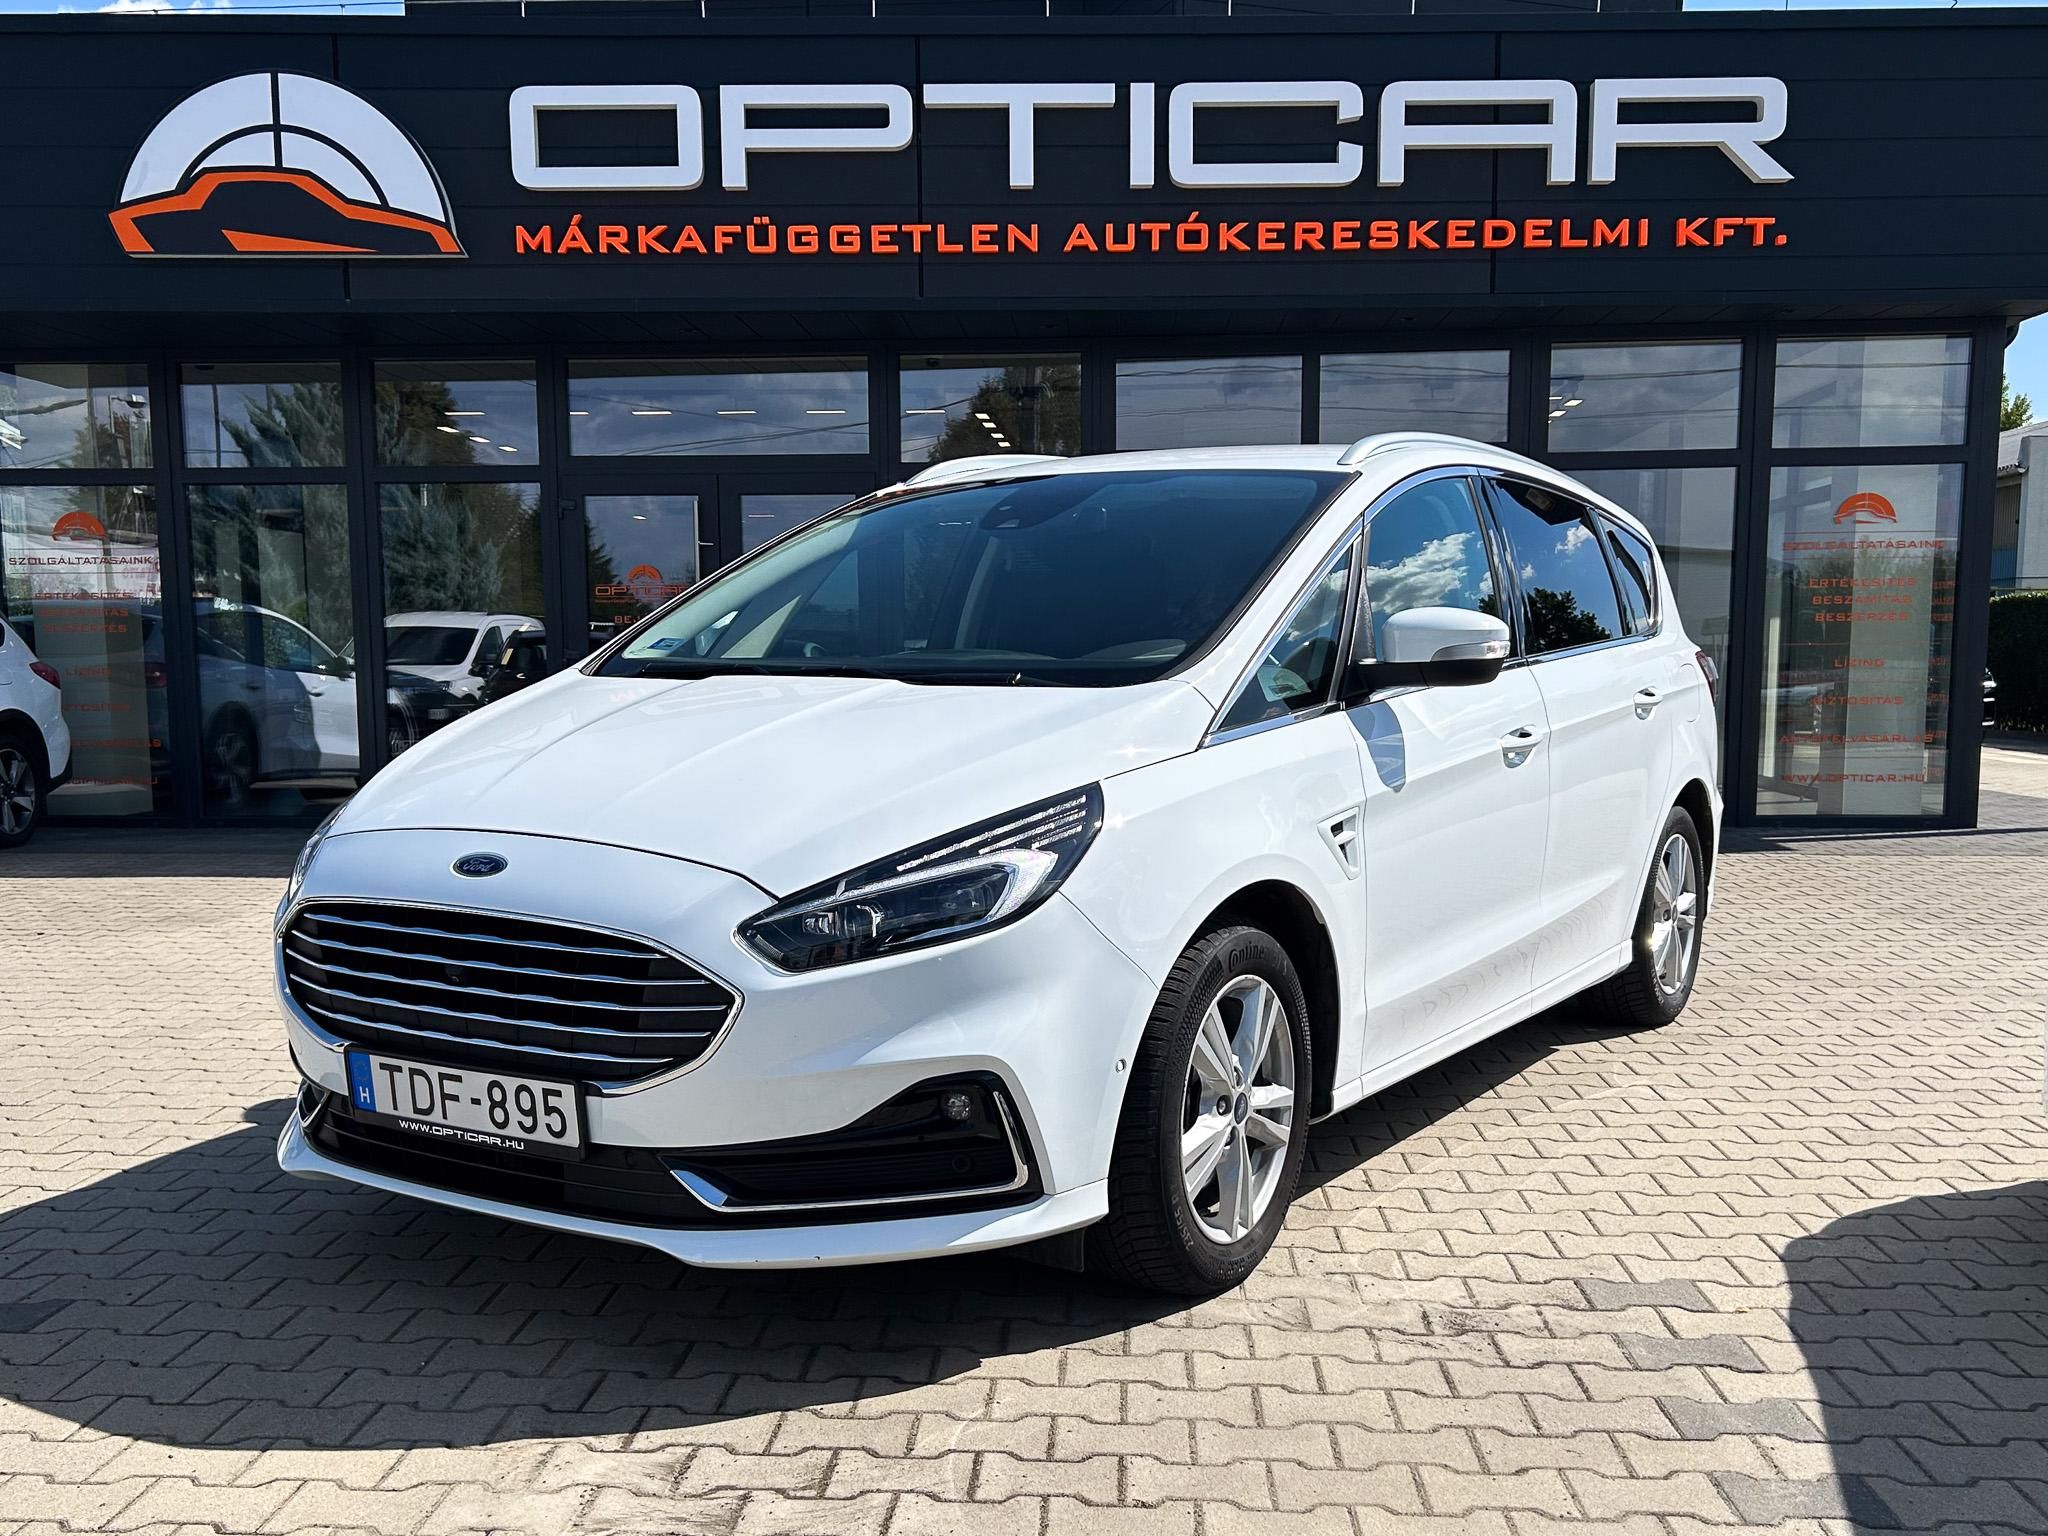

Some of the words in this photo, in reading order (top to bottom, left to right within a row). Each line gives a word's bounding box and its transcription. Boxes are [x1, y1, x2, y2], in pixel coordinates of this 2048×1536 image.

[509, 77, 1794, 191] OPTICAR
[515, 214, 1039, 256] MÁRKAFÜGGETLEN
[1062, 211, 1650, 253] AUTÓKERESKEDELMI
[1675, 217, 1790, 248] KFT.
[359, 1086, 371, 1105] H
[378, 1061, 569, 1139] TDF-895
[398, 1119, 526, 1151] WWW.OPTICAR.HU
